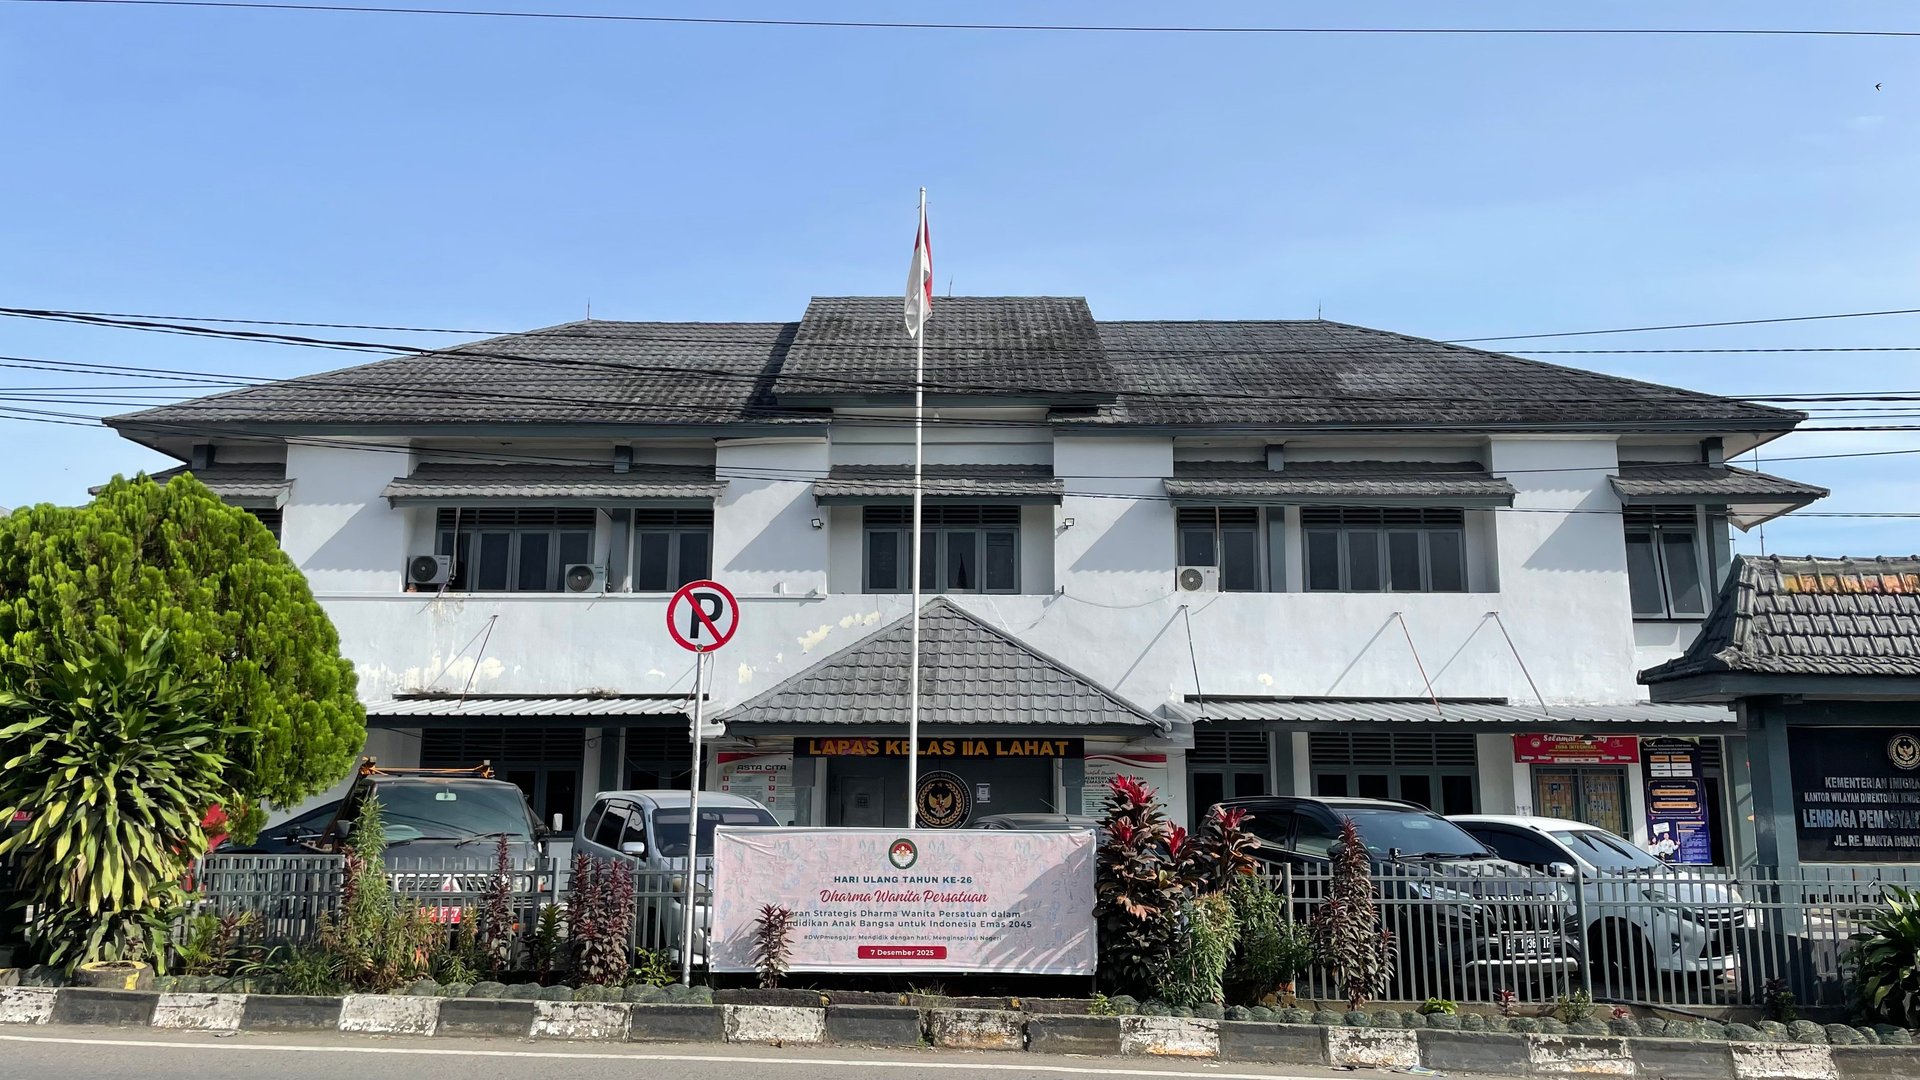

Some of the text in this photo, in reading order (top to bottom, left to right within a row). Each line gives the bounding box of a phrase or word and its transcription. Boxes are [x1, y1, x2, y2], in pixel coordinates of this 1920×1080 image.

[690, 592, 723, 639] P
[809, 740, 1069, 756] LAPAS KELAS IIA LAHAT
[1825, 777, 1887, 789] KEMENTERIAN
[1804, 792, 1830, 802] KANTOR
[1831, 792, 1860, 802] WILAYAH
[1803, 809, 1858, 828] LEMBAGA
[1834, 835, 1847, 846] JL.
[1864, 835, 1893, 847] MARTA
[1894, 836, 1920, 847] DINAT
[903, 876, 939, 884] TAHUN
[943, 876, 973, 884] KE-26
[820, 889, 989, 903] Dharma Wanita Persatuan
[789, 910, 811, 918] eran
[813, 909, 857, 919] Strategis
[901, 910, 936, 918] Wanita
[939, 910, 988, 918] Persatuan
[991, 910, 1021, 918] dalam
[860, 920, 895, 928] Bangsa
[898, 920, 926, 928] untuk
[930, 920, 977, 928] Indonesia
[981, 920, 1006, 928] Emas
[1009, 920, 1032, 928] 2045
